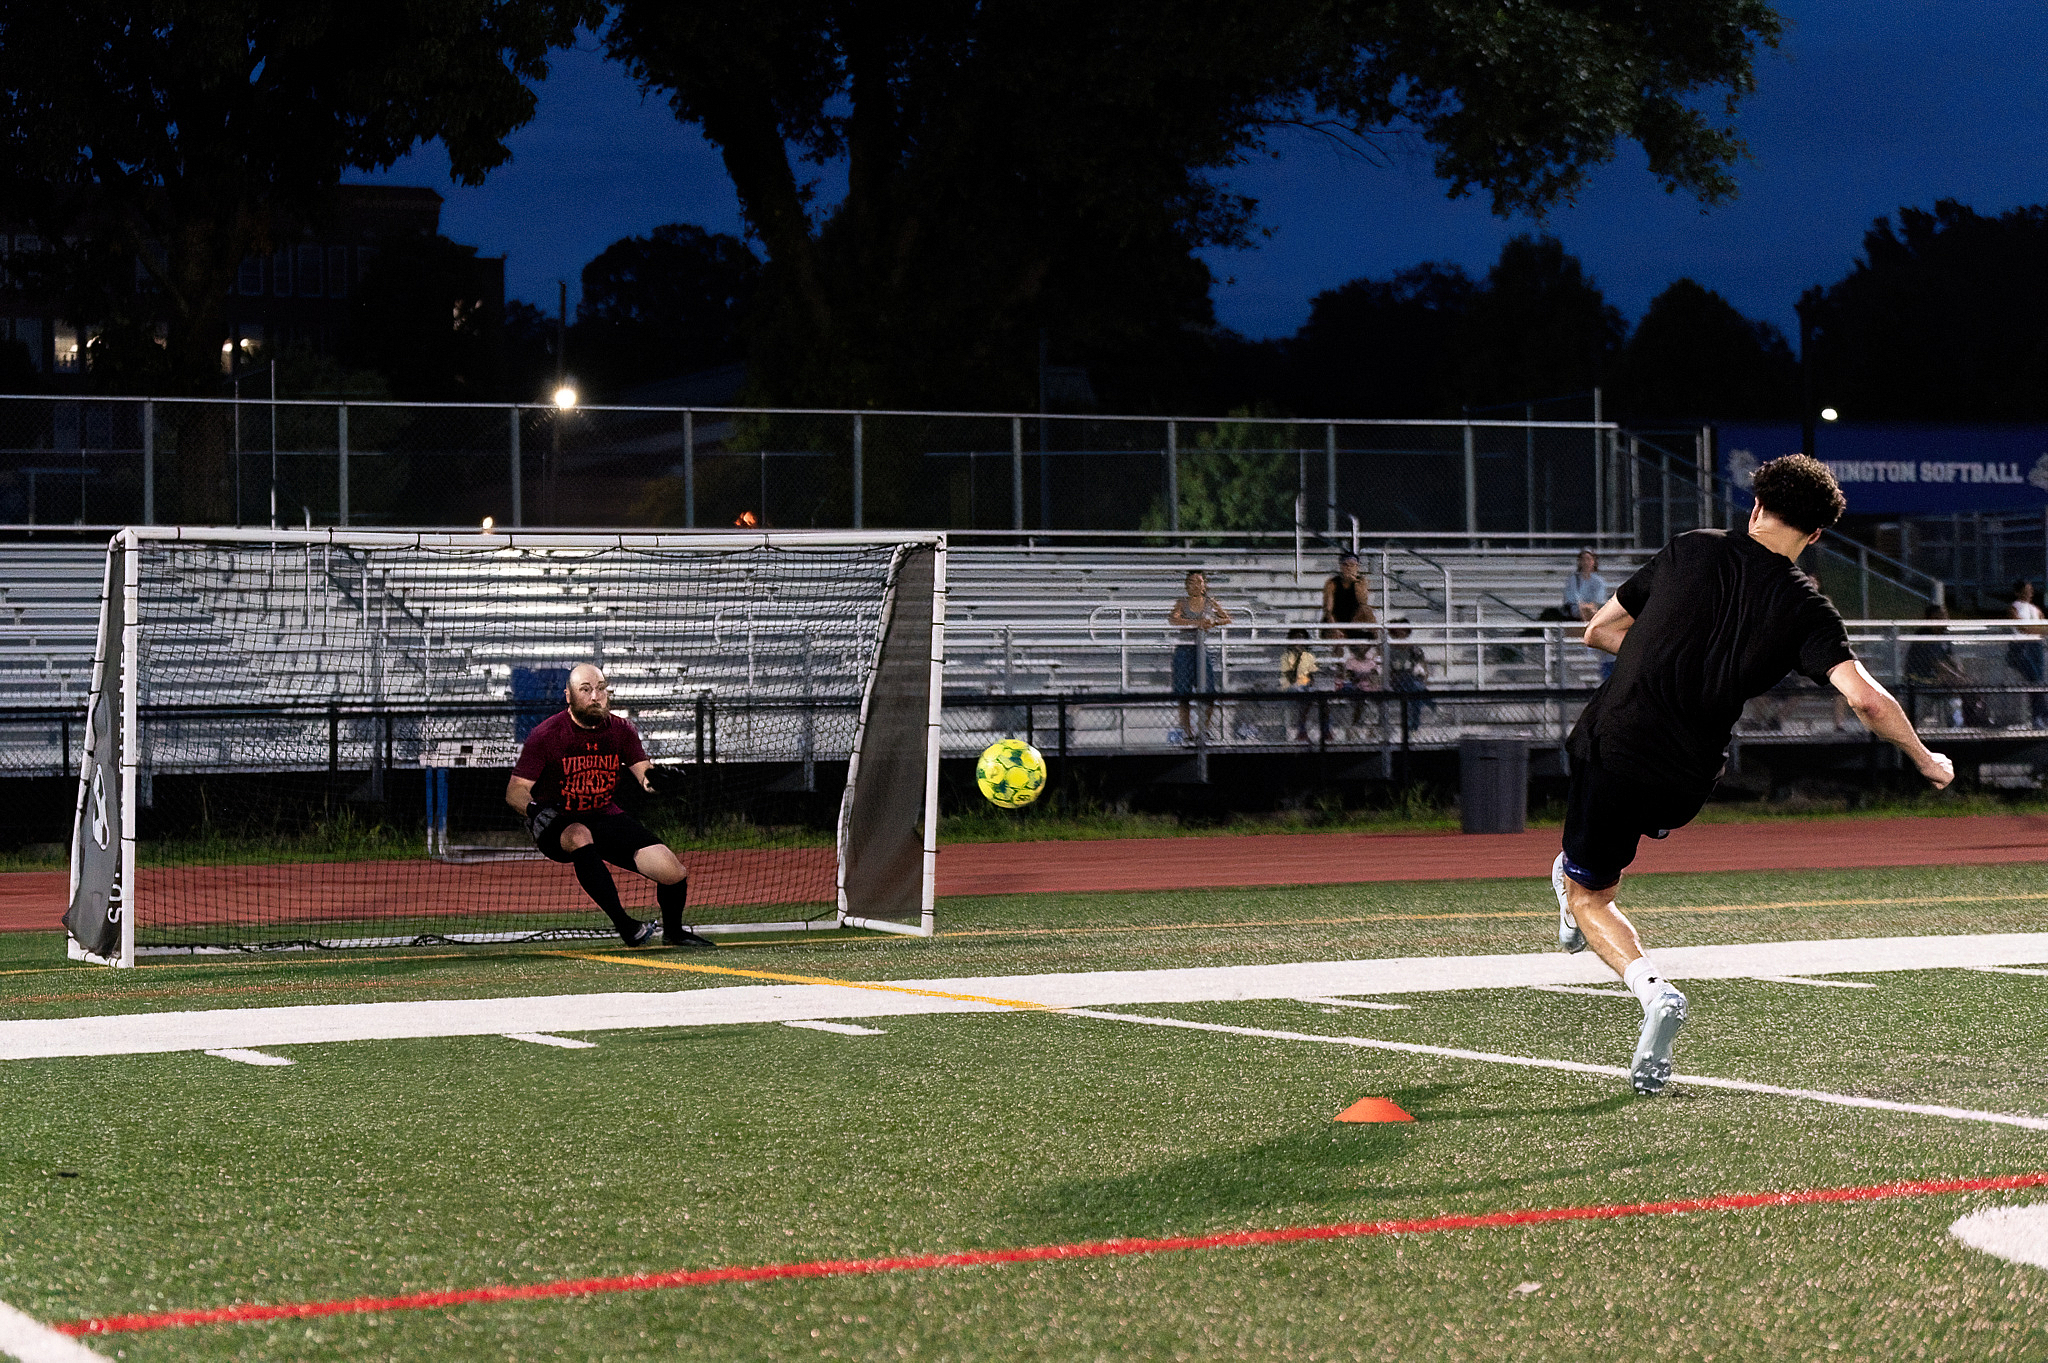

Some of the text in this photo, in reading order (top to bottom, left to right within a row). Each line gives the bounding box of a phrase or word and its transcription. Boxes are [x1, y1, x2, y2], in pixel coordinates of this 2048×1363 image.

[1920, 462, 2024, 483] SOFTBALL
[562, 754, 620, 775] VIRGINIA
[564, 769, 616, 794] HOKIES
